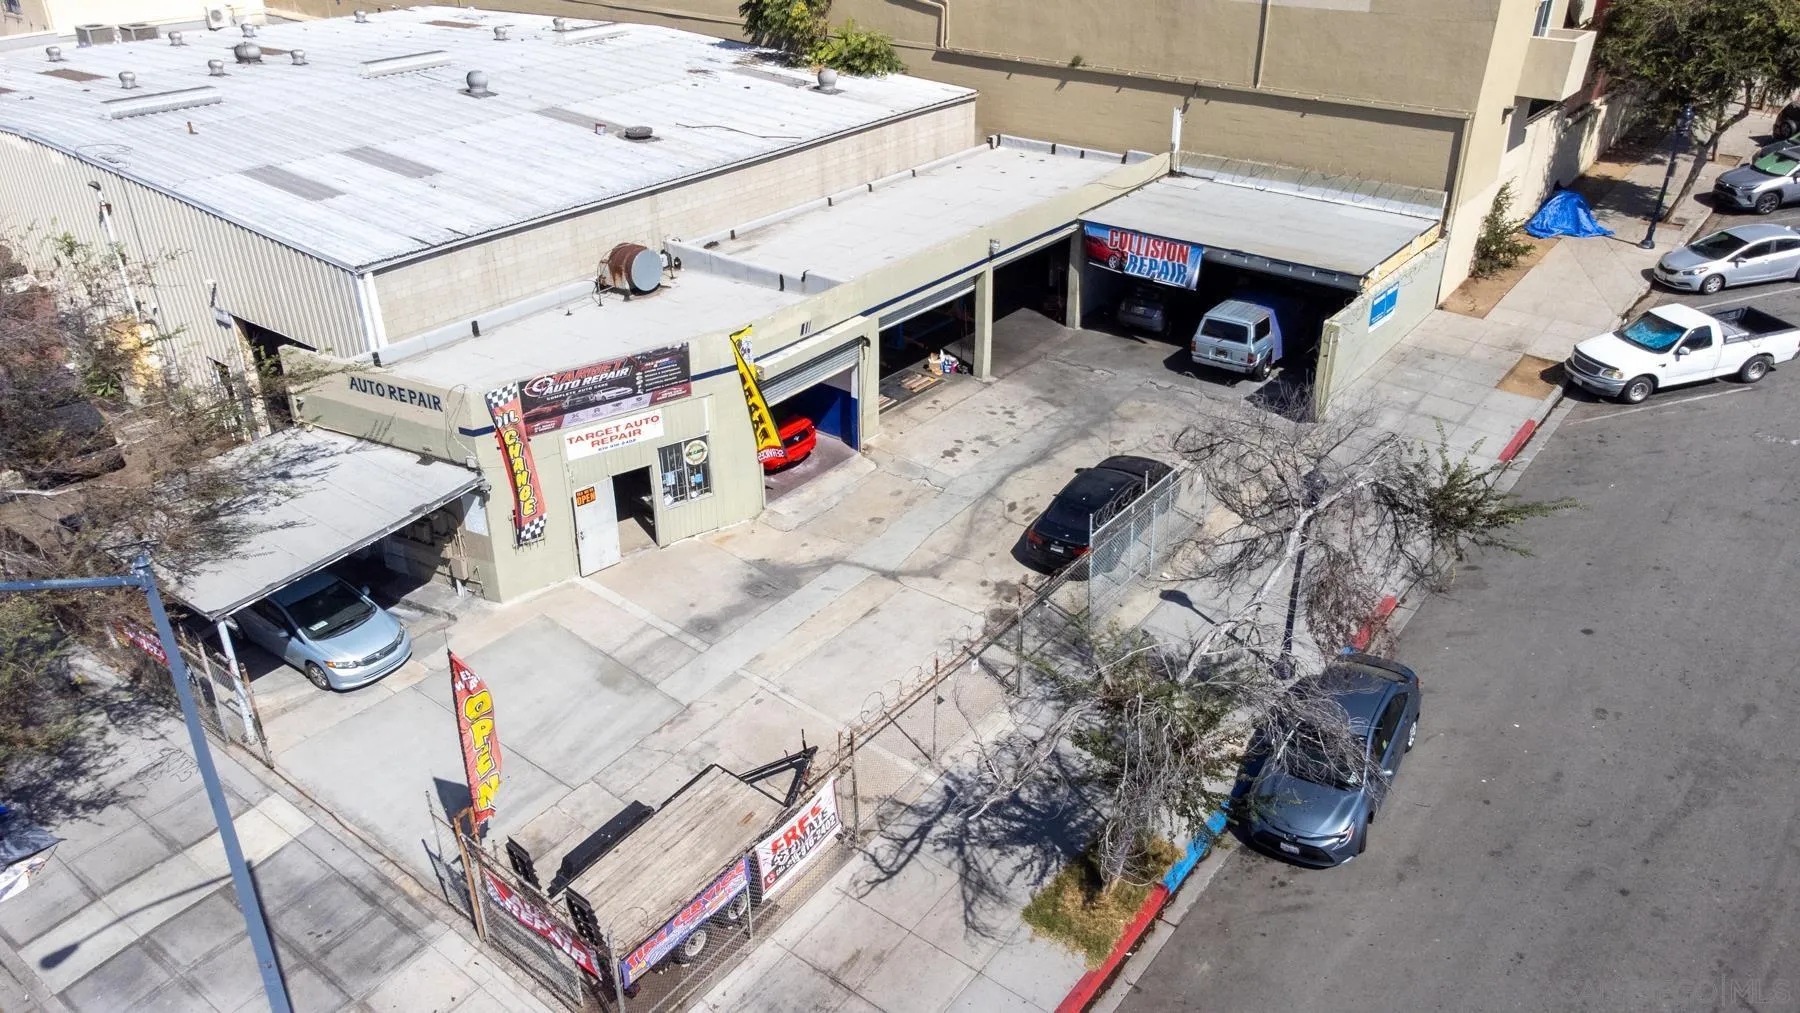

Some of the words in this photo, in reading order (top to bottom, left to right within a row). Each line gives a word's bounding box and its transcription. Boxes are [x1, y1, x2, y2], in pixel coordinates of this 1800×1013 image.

[1108, 229, 1190, 264] COLLISION
[1123, 254, 1188, 284] REPAIR
[349, 376, 386, 398] AUTO
[388, 383, 443, 413] REPAIR
[543, 379, 580, 396] AUTO
[582, 367, 631, 387] REPAIR
[494, 409, 520, 429] OIL
[566, 425, 622, 446] TARGET
[624, 415, 660, 431] AUTO
[590, 428, 643, 448] REPAIR
[504, 429, 538, 517] CHANGE
[575, 491, 597, 507] OPEN
[463, 690, 500, 811] OPEN
